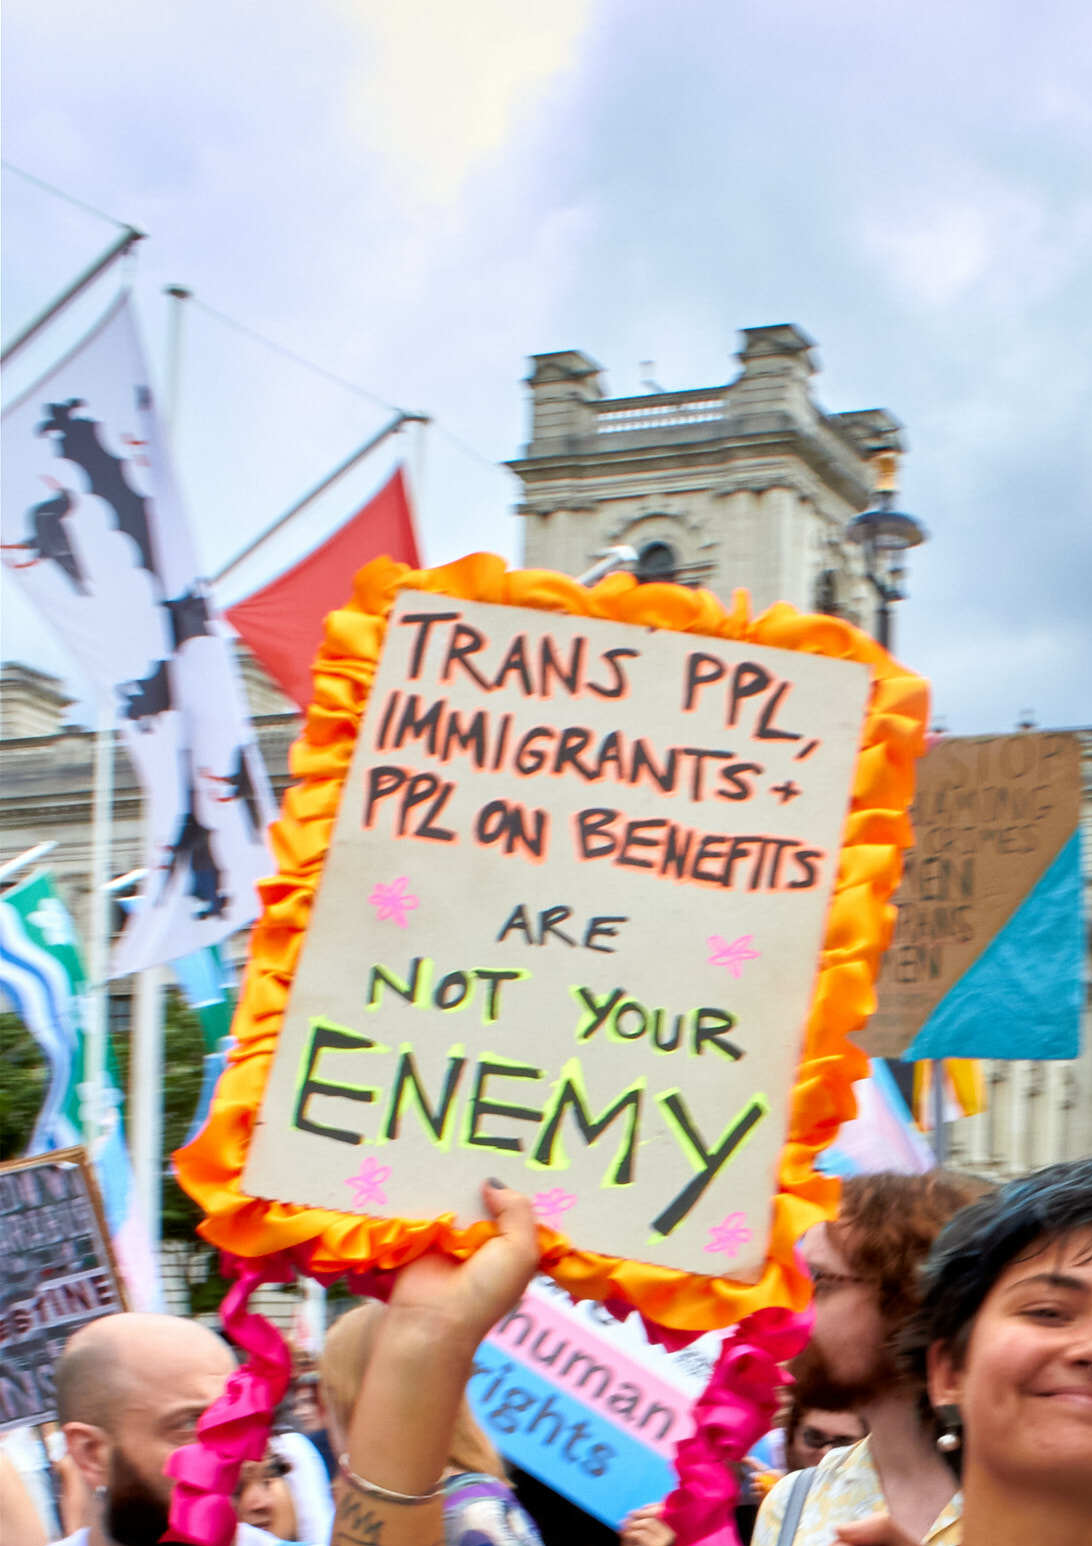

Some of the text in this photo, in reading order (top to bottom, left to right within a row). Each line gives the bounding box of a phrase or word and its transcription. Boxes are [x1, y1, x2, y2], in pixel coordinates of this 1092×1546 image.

[401, 612, 822, 761] TRANS PPL,
[364, 765, 824, 892] PPL ON BENEFITS
[497, 904, 629, 953] ARE
[368, 957, 744, 1061] NOT YOUR
[296, 1024, 766, 1238] ENEMY
